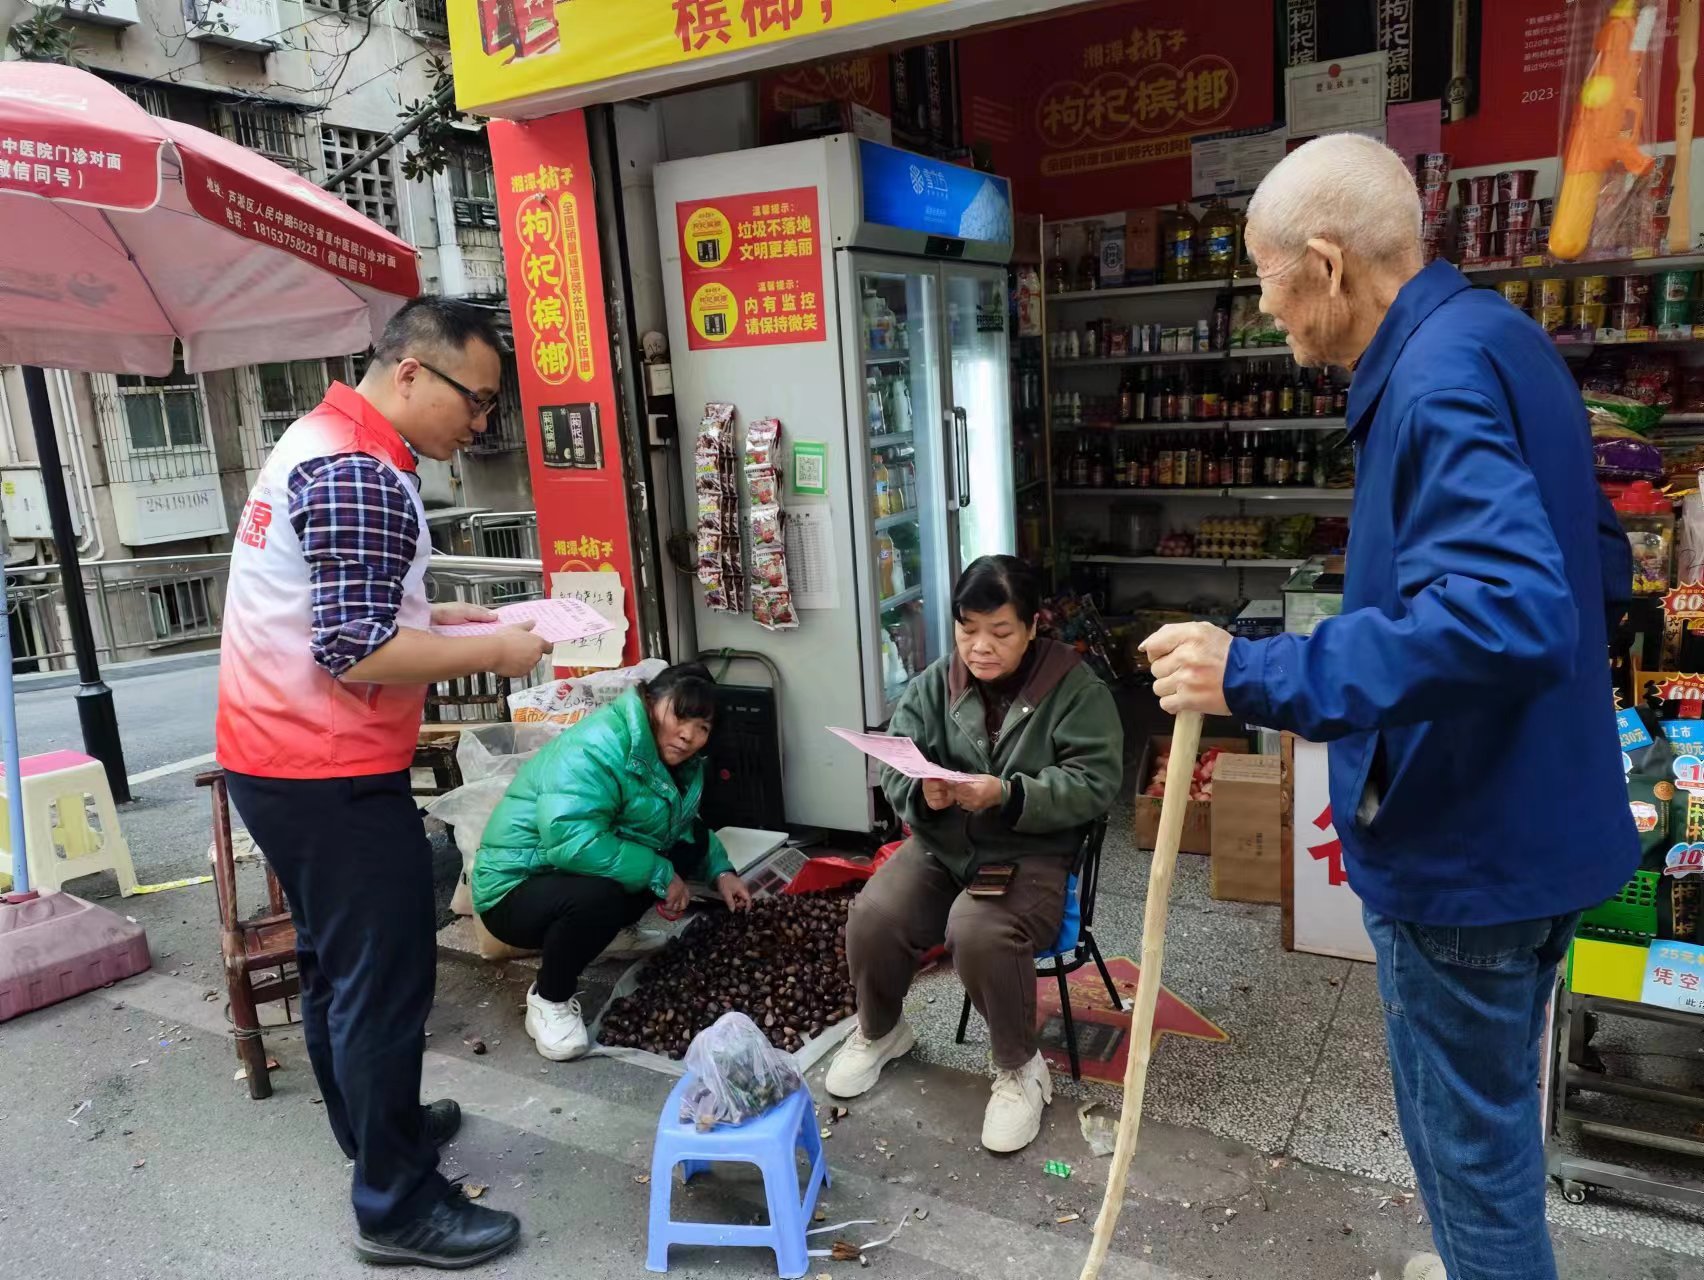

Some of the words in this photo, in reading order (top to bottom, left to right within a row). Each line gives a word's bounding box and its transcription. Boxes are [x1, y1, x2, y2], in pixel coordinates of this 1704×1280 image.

[1043, 68, 1231, 136] 枸杞槟榔
[738, 215, 812, 239] 垃圾不落地
[739, 238, 813, 262] 文明更美丽
[521, 207, 569, 375] 枸杞槟榔
[745, 313, 818, 335] 请保持微笑
